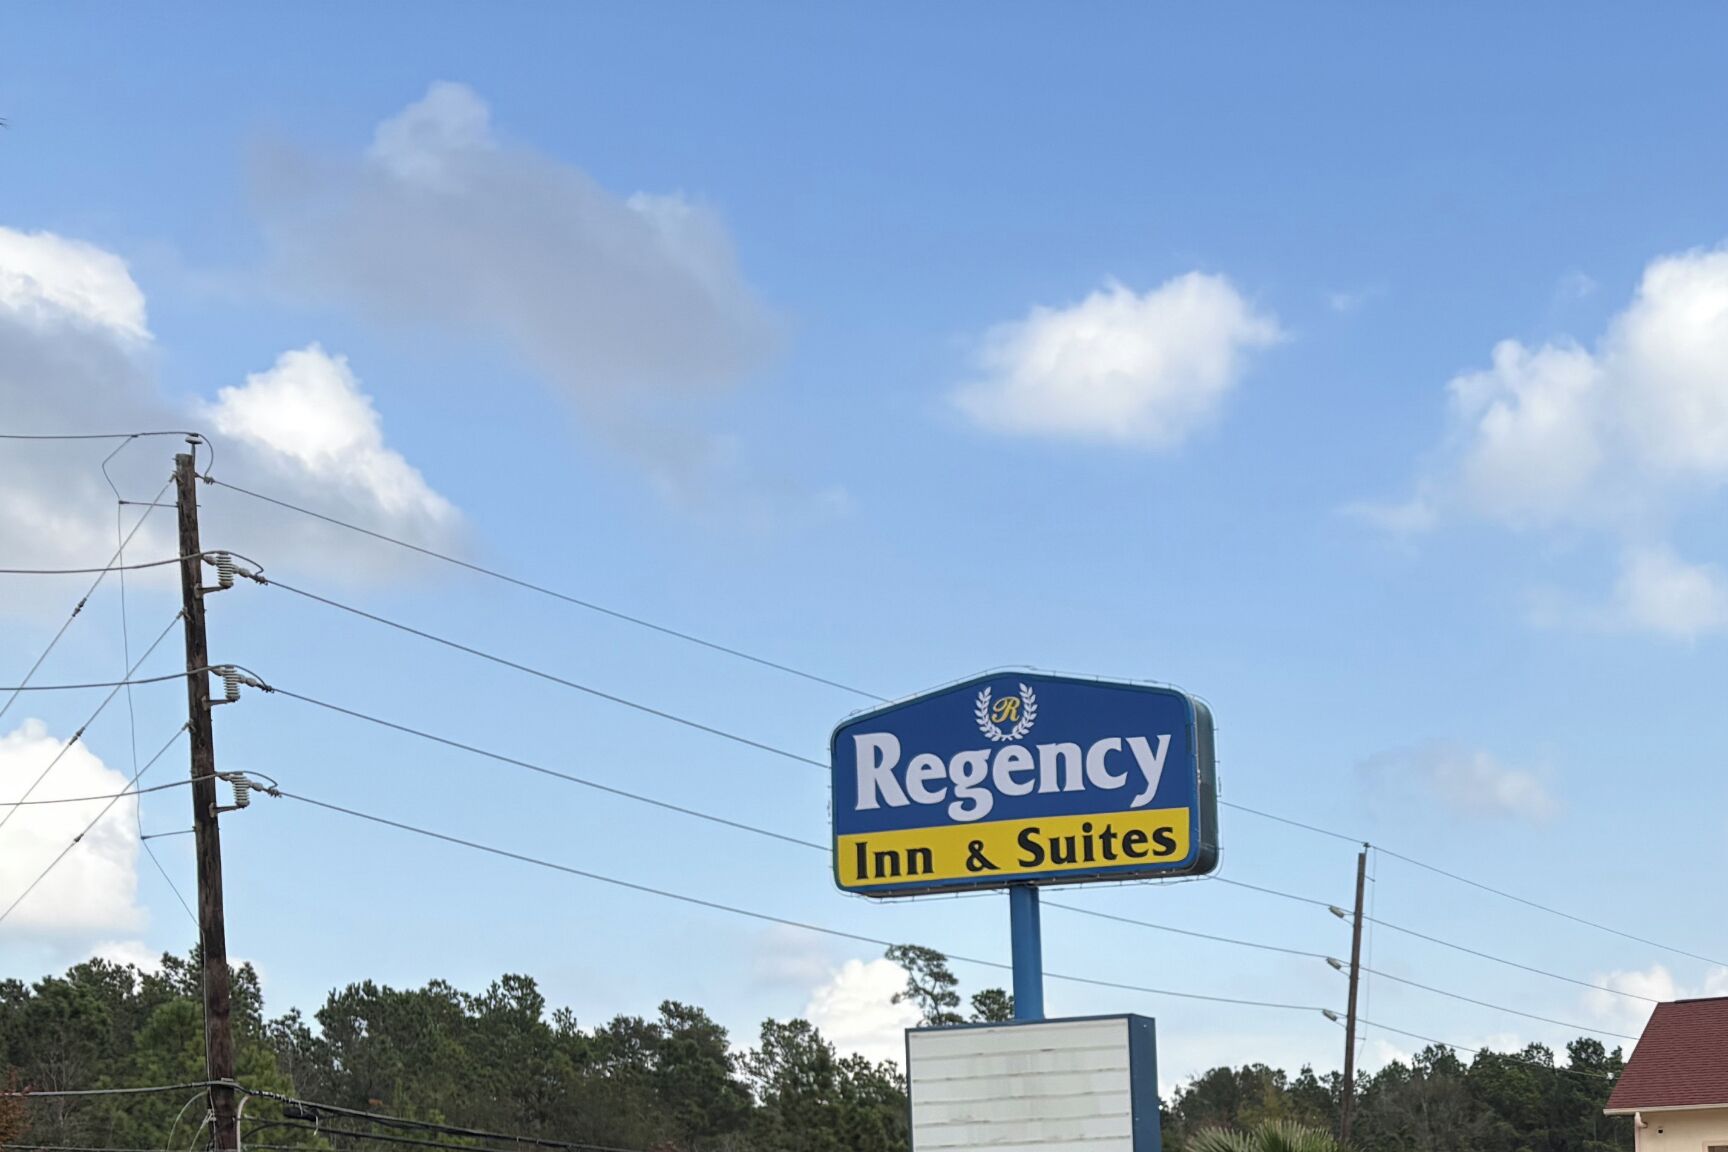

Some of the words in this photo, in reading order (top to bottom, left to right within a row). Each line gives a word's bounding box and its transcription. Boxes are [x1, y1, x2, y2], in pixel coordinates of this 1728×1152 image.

[852, 731, 1172, 822] Regency
[855, 841, 935, 880] Inn
[965, 839, 1000, 873] &
[1017, 822, 1178, 868] Suites
